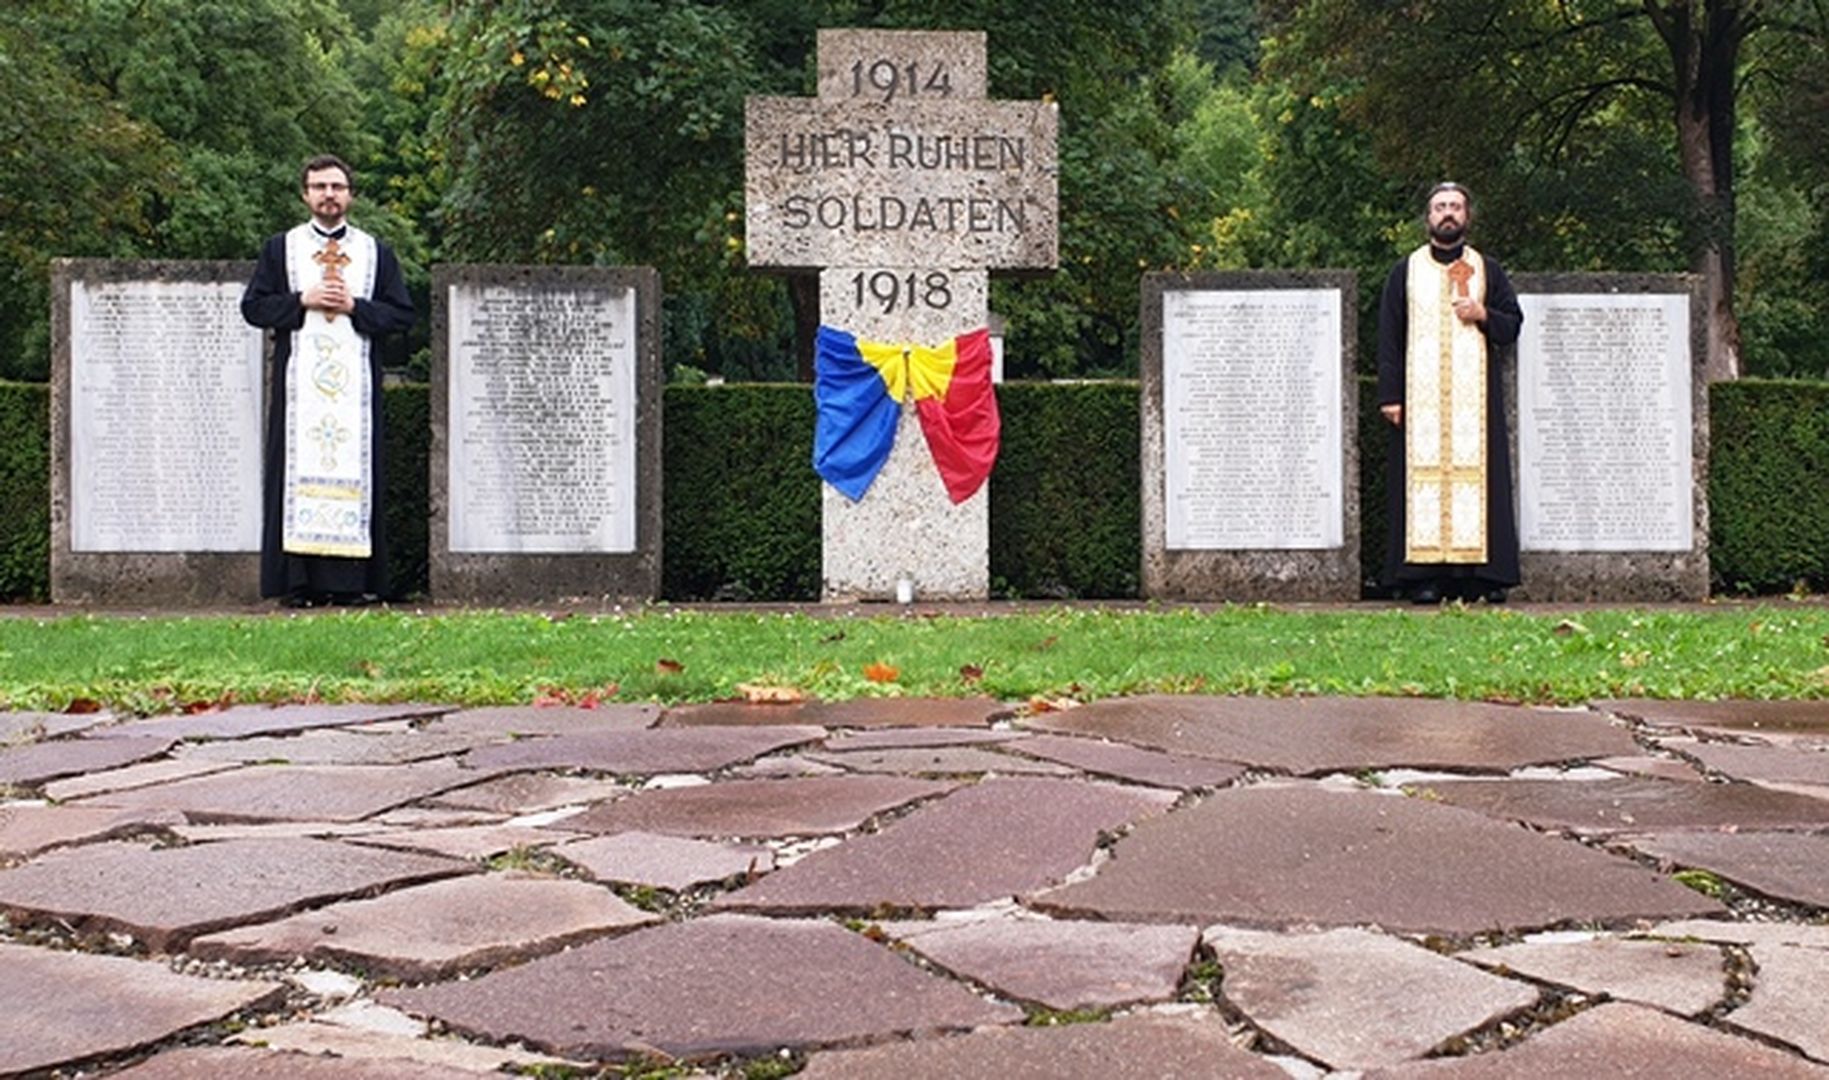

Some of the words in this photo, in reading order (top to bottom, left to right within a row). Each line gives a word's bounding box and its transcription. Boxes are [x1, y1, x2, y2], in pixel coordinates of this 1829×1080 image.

[852, 59, 952, 100] 1914
[781, 134, 875, 169] HIER
[889, 135, 1025, 170] RUHEN
[784, 196, 1026, 232] SOLDATEN
[853, 271, 951, 313] 1918
